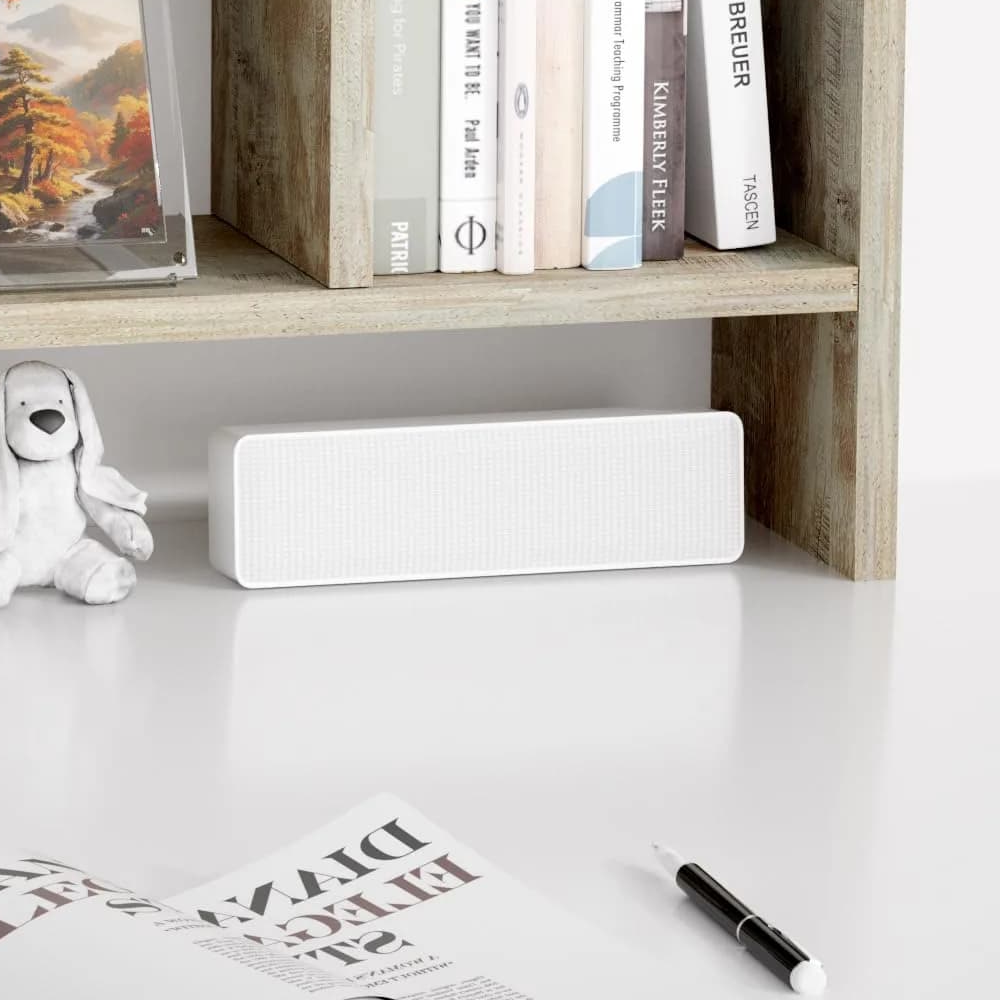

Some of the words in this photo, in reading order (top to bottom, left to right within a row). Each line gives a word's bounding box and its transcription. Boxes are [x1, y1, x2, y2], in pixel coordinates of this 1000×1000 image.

[393, 18, 406, 37] for
[464, 3, 482, 24] YOU
[465, 29, 481, 59] WANT
[610, 39, 625, 81] Teaching
[729, 2, 751, 88] BREUER
[392, 44, 406, 95] Pirates
[464, 64, 481, 77] TO
[464, 120, 480, 142] Paul
[610, 85, 624, 142] Programme
[652, 81, 670, 171] KIMBERLY
[464, 148, 480, 178] Arden
[651, 178, 668, 232] FLEEK
[742, 174, 759, 231] TASCEN
